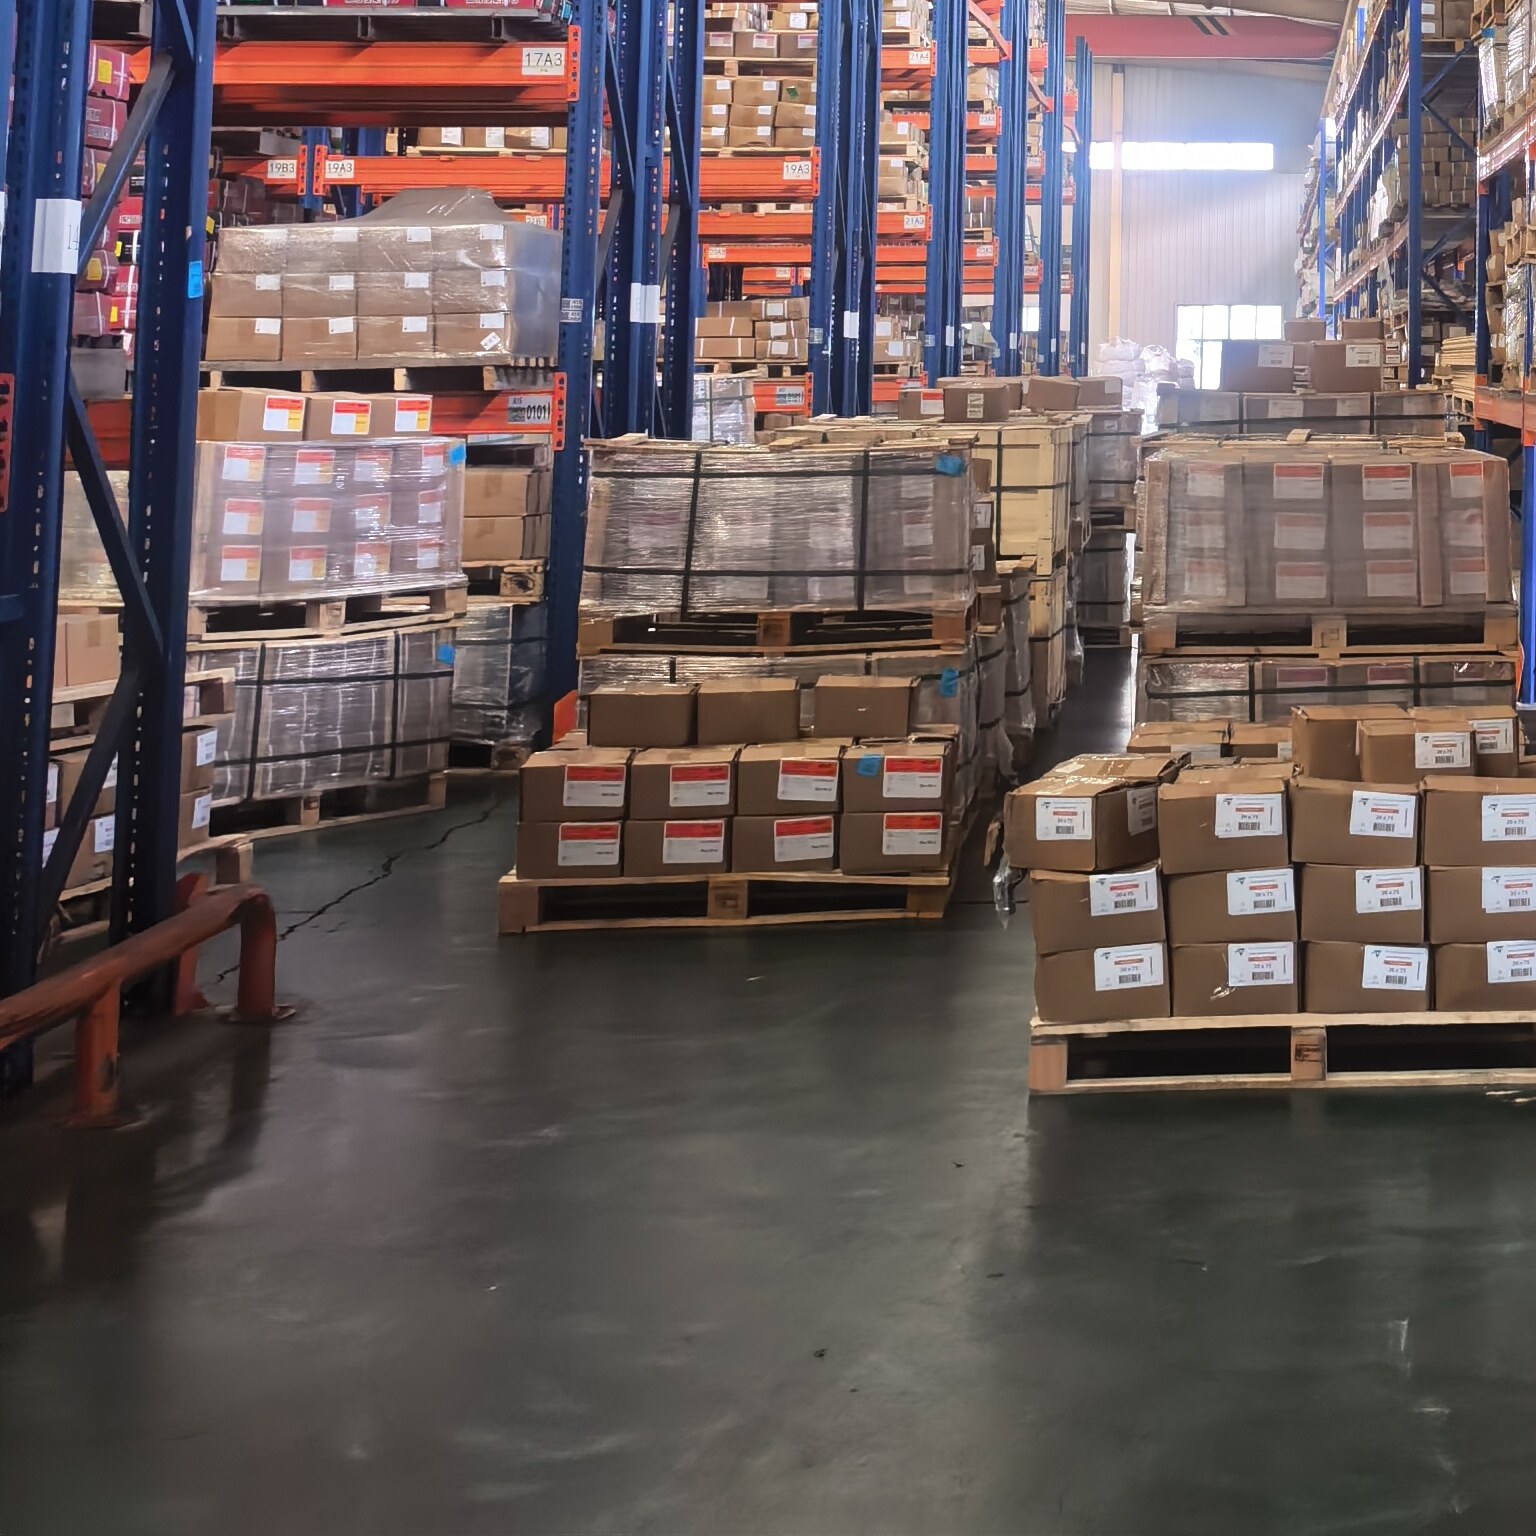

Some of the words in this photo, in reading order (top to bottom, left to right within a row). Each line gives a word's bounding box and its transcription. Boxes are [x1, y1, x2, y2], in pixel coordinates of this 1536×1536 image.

[525, 52, 562, 66] 17A3
[270, 162, 295, 174] 19B3
[327, 162, 352, 174] 19A3
[785, 164, 810, 174] 19A3
